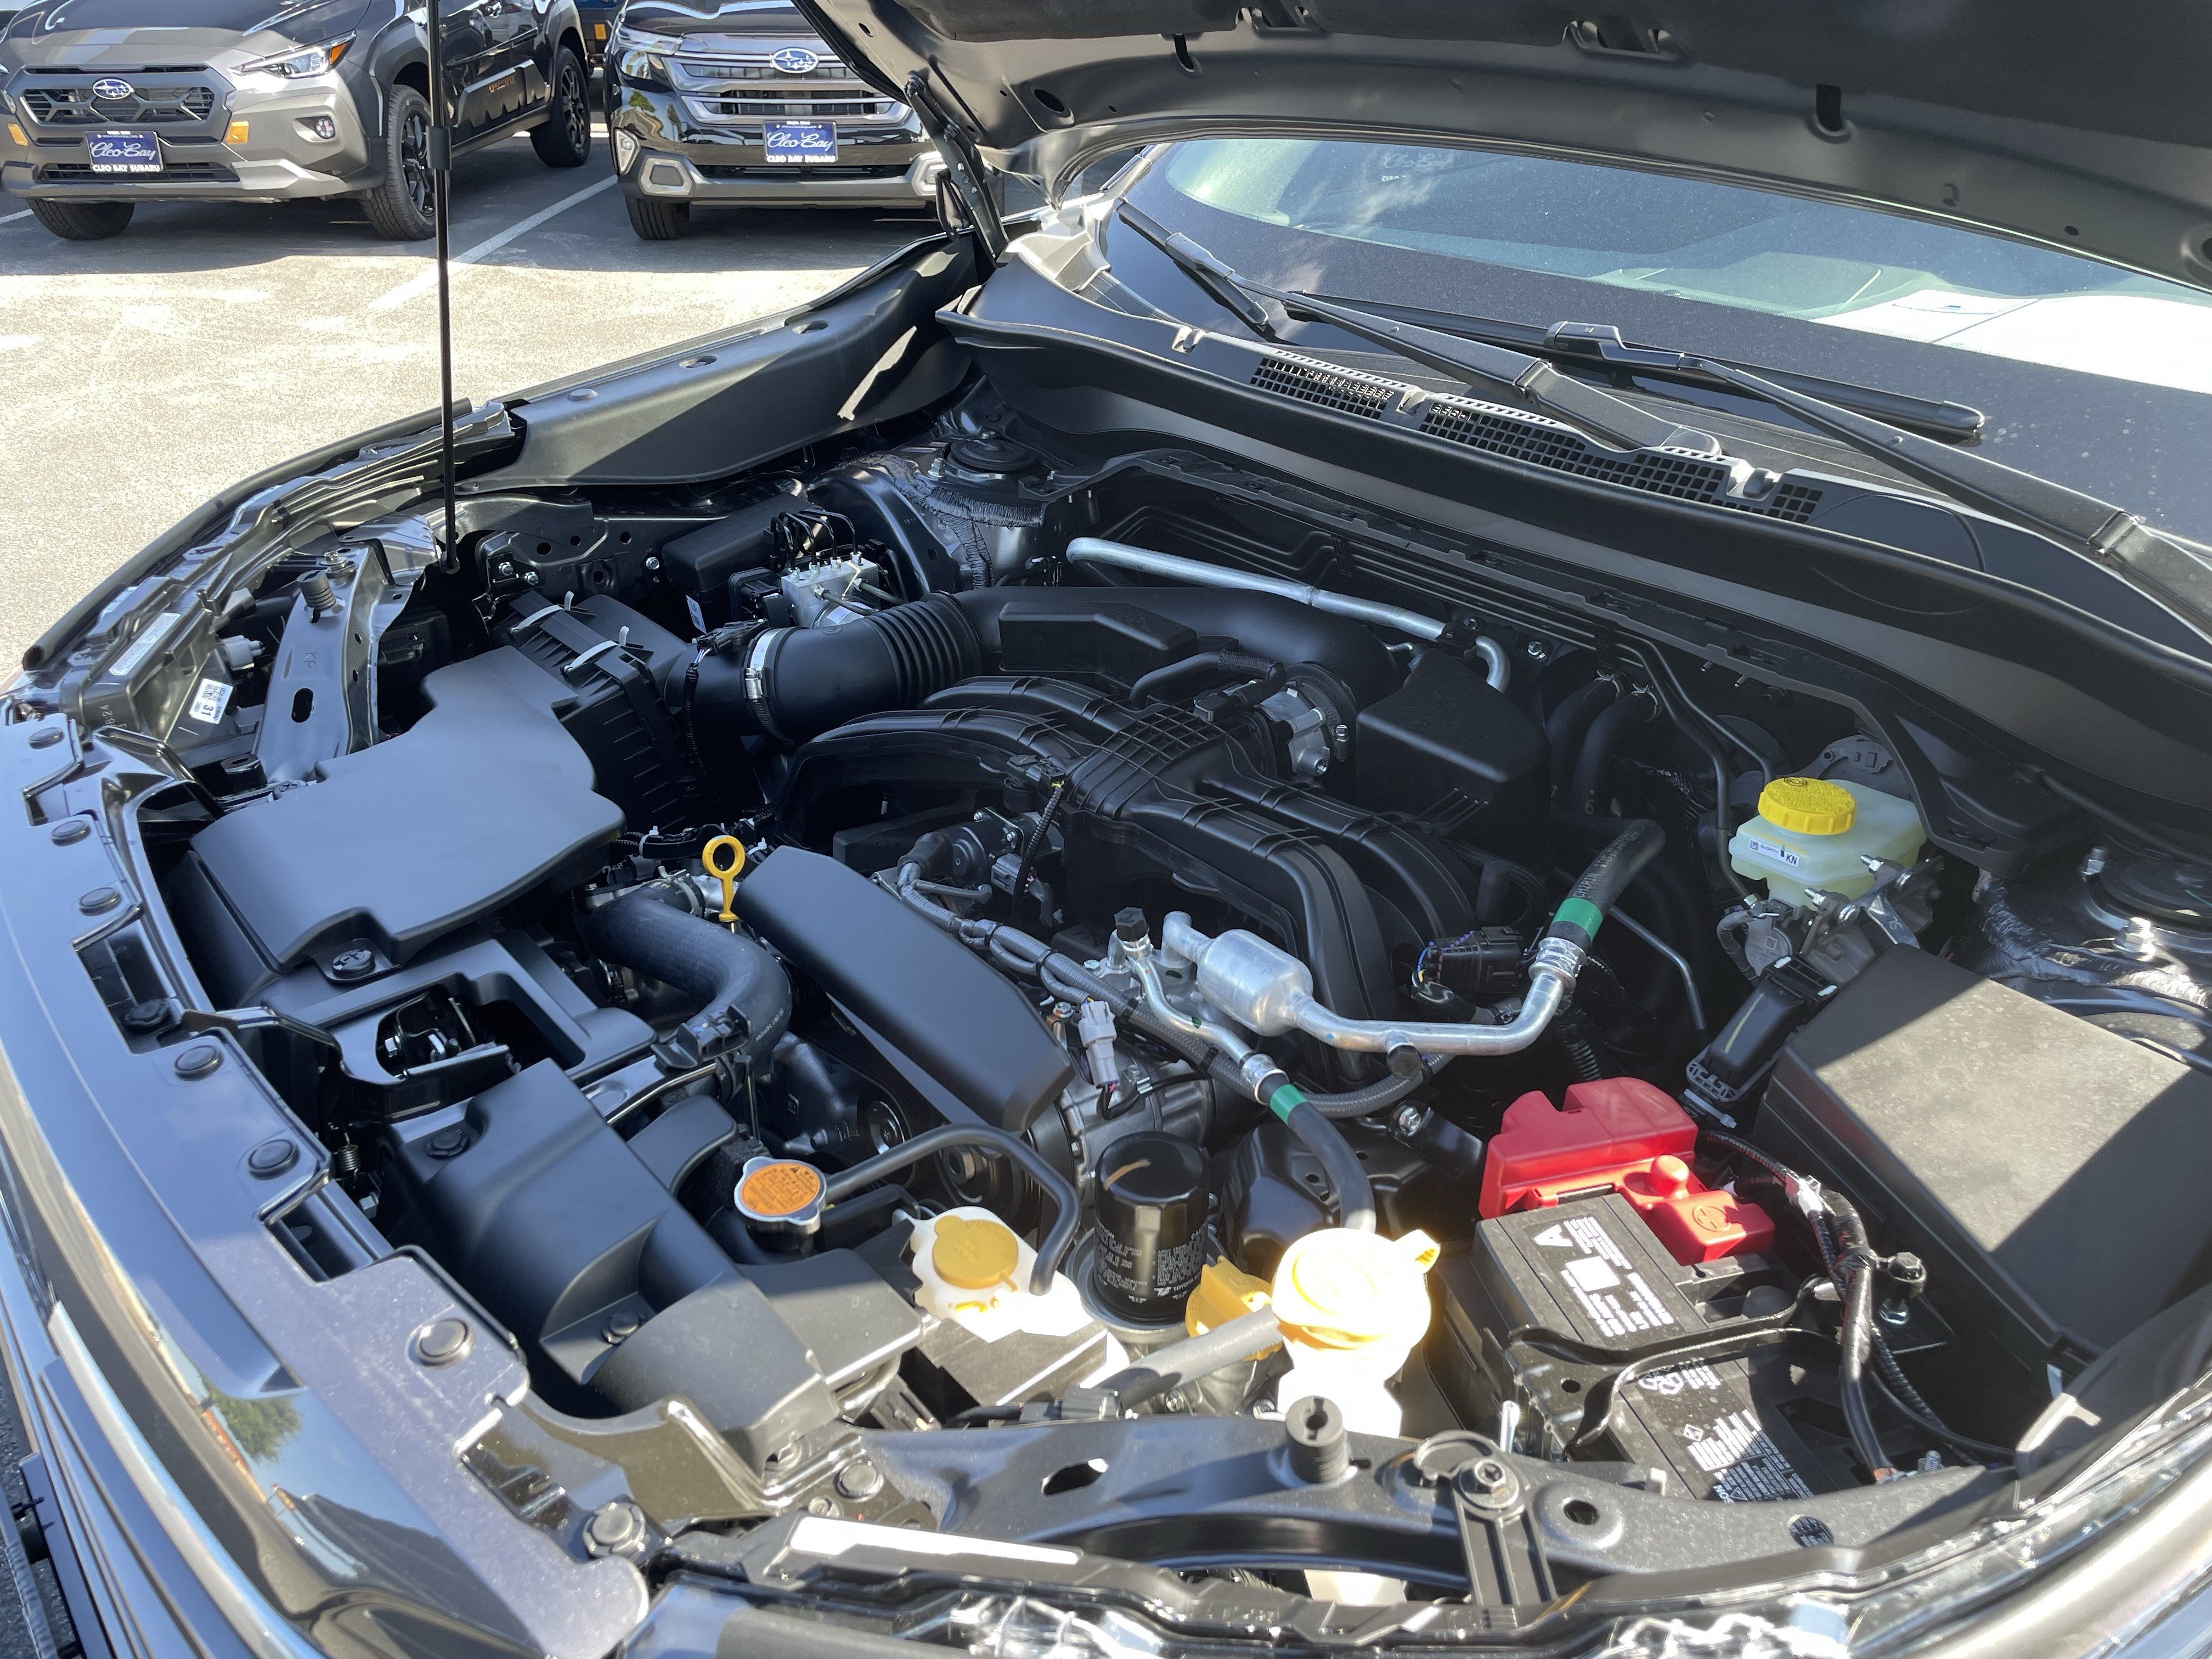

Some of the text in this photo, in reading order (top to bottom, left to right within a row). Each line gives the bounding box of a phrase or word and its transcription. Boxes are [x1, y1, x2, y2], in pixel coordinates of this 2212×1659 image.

[201, 704, 215, 716] 31
[1785, 853, 1798, 865] KN
[1173, 1278, 1194, 1291] TOYOTA
